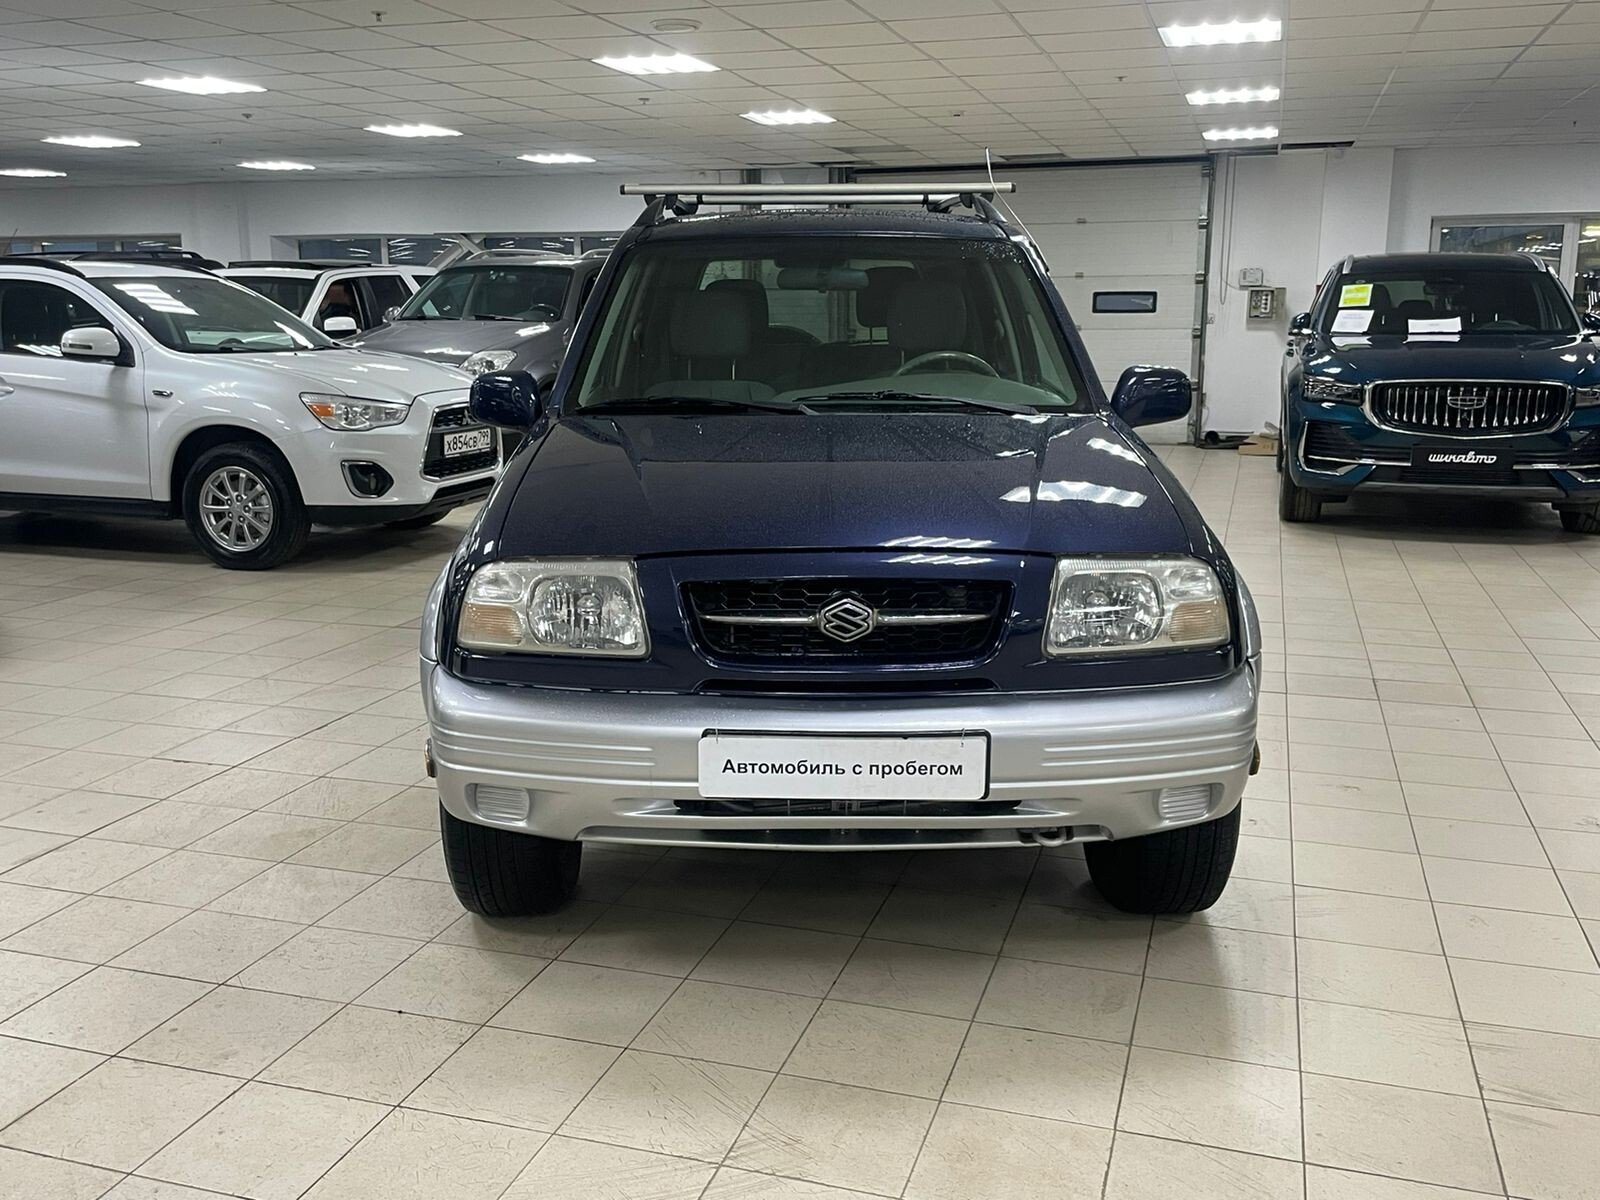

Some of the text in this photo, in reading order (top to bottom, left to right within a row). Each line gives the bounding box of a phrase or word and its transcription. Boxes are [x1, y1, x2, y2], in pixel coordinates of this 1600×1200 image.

[722, 759, 963, 778] Автомобиль с пробегом
